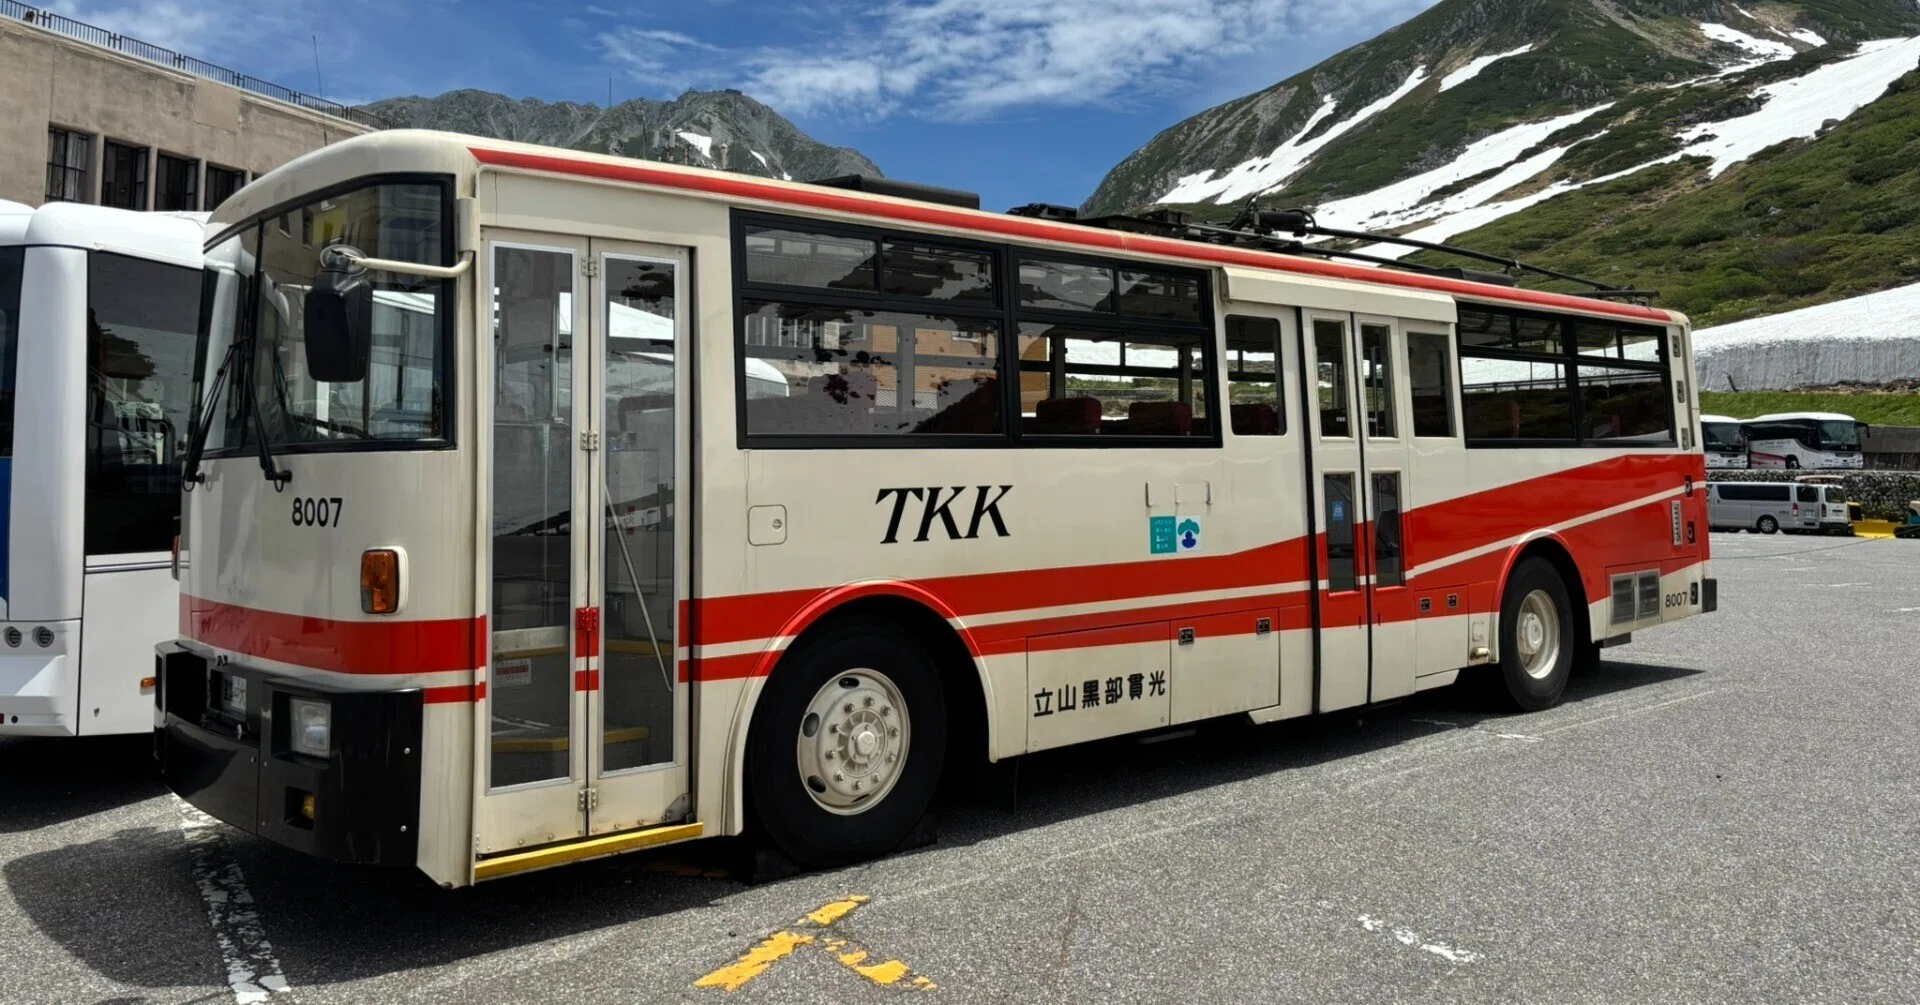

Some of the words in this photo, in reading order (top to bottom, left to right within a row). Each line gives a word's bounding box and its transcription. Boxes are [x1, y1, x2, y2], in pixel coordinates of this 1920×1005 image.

[292, 497, 343, 528] 8007
[875, 484, 1014, 544] TKK
[1665, 591, 1687, 608] 8007
[1033, 670, 1166, 718] 立山黒部貫光
